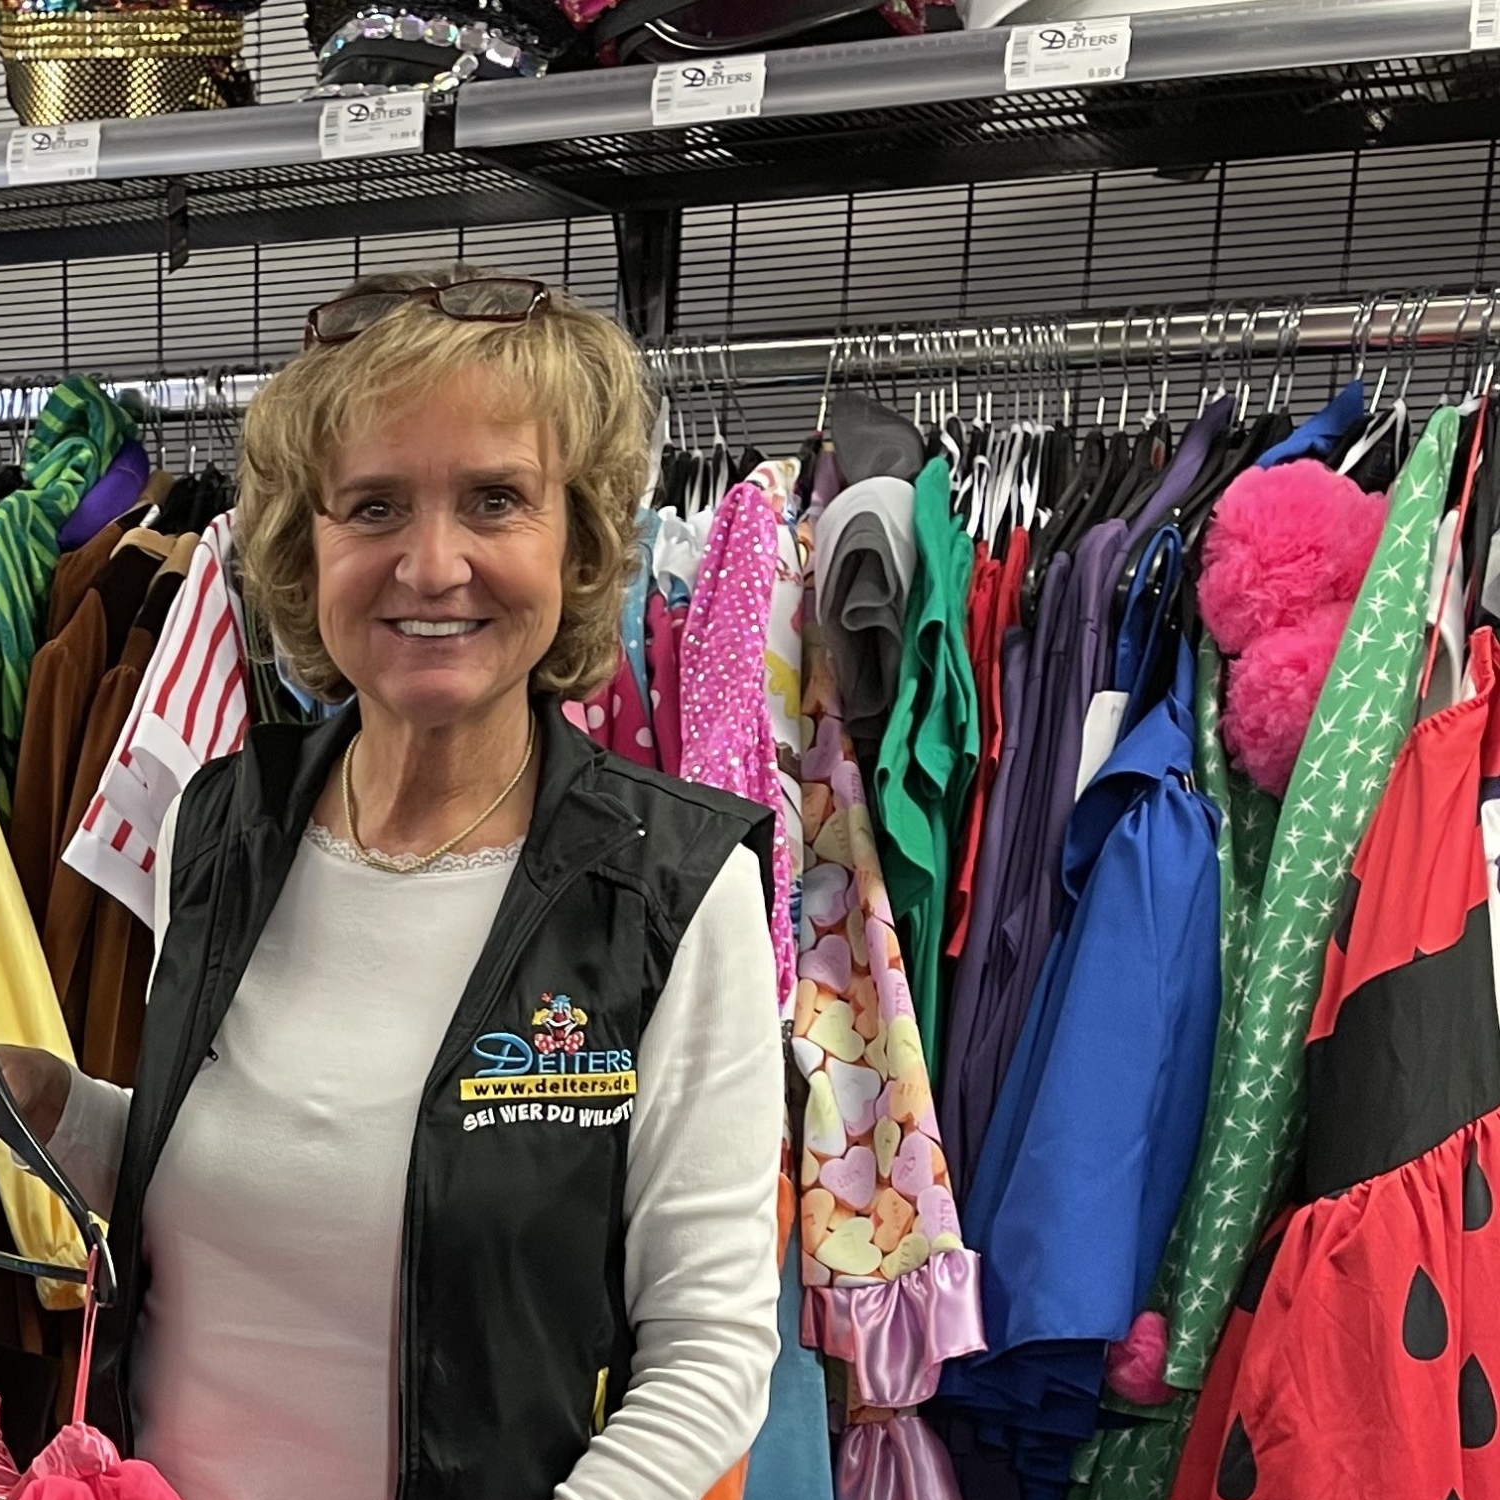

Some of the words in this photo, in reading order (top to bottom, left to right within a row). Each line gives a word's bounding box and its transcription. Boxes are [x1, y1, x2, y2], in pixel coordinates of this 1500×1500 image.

[1039, 29, 1117, 50] DEITERS
[682, 68, 752, 88] DEITERS
[347, 103, 412, 123] DEITERS
[472, 1032, 633, 1077] DEITERS
[473, 1077, 630, 1096] www.deiters.de
[462, 1108, 495, 1132] SEI
[500, 1102, 543, 1124] WER
[546, 1103, 575, 1124] DU
